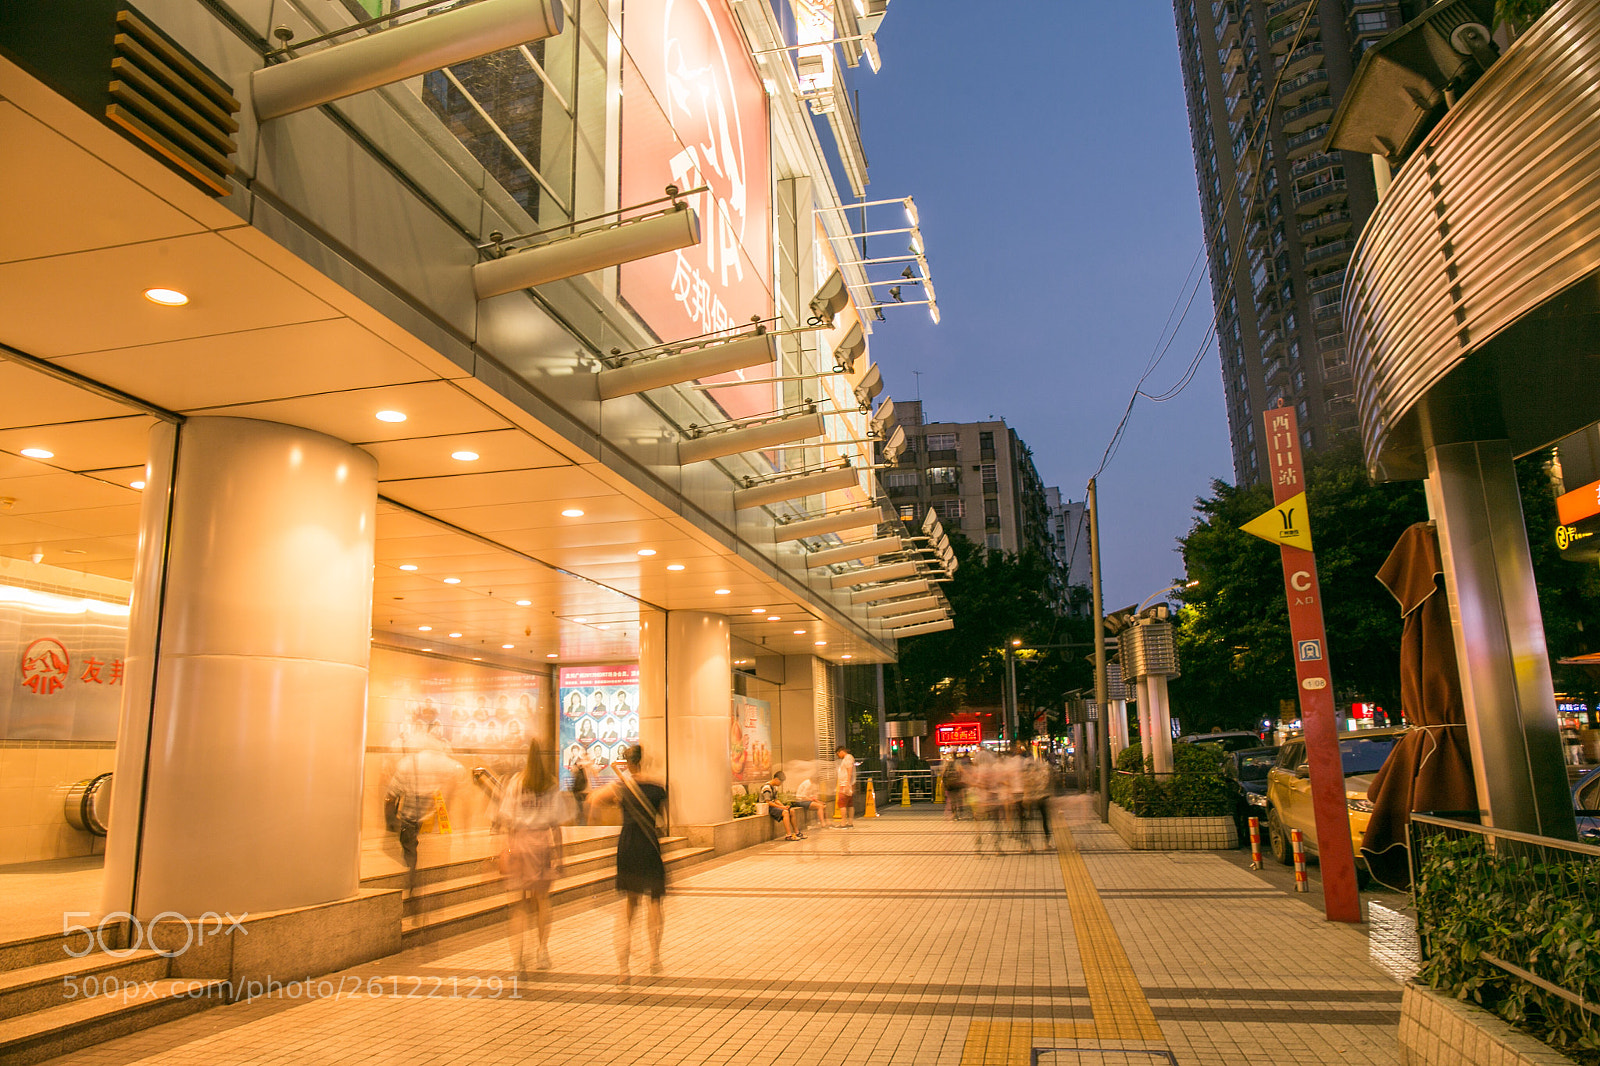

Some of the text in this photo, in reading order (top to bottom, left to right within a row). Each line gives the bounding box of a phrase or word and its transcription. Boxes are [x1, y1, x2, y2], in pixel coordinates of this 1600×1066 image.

[1272, 413, 1297, 486] 西门口站
[1291, 571, 1312, 592] C
[1295, 597, 1314, 606] 入口
[22, 674, 64, 695] AIA
